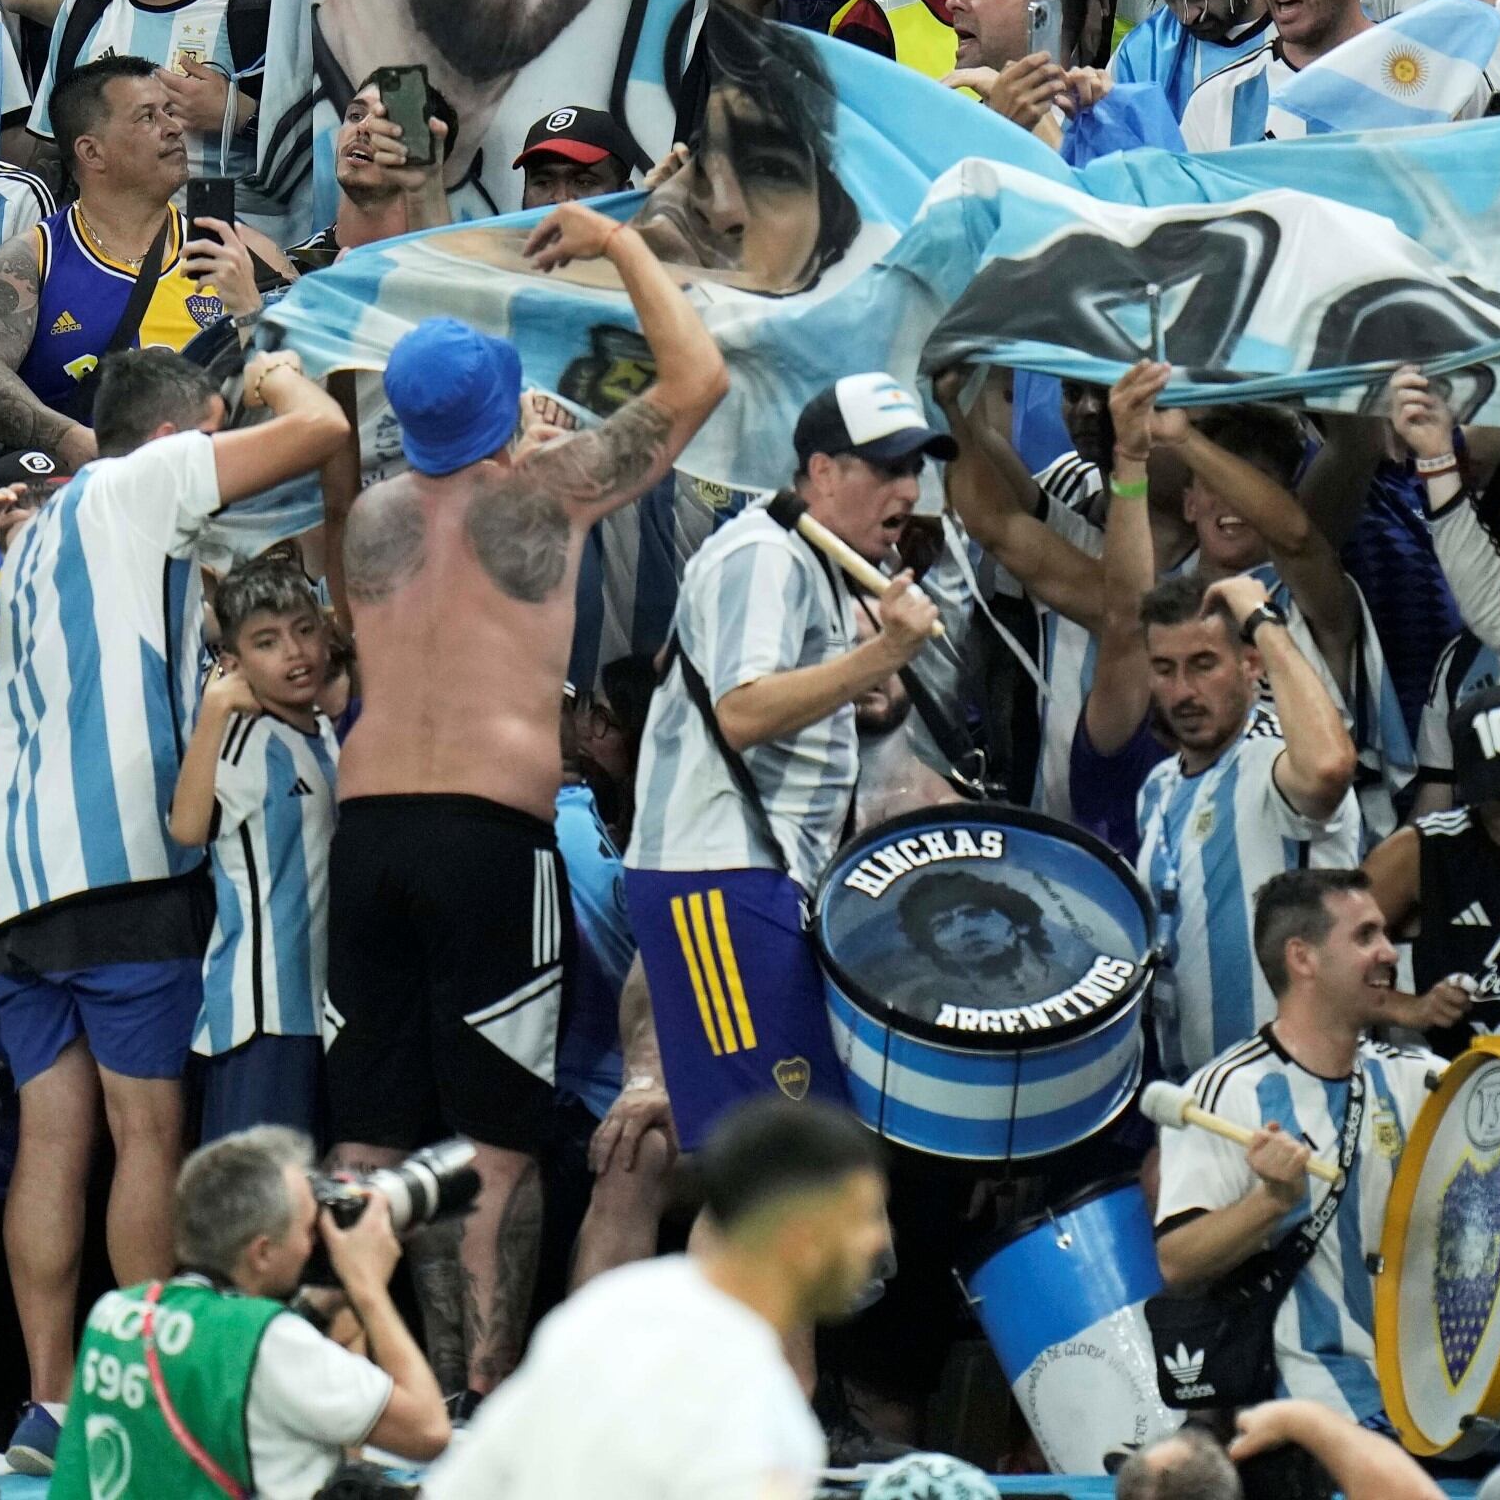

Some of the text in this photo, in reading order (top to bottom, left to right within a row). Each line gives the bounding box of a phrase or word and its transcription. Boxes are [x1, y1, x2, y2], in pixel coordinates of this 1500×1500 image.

[49, 322, 83, 337] adidas
[844, 829, 1004, 899] HINCHAS
[936, 953, 1136, 1035] ARGENTINOS
[1342, 1100, 1363, 1169] adidas
[1064, 1342, 1106, 1360] GLORIA
